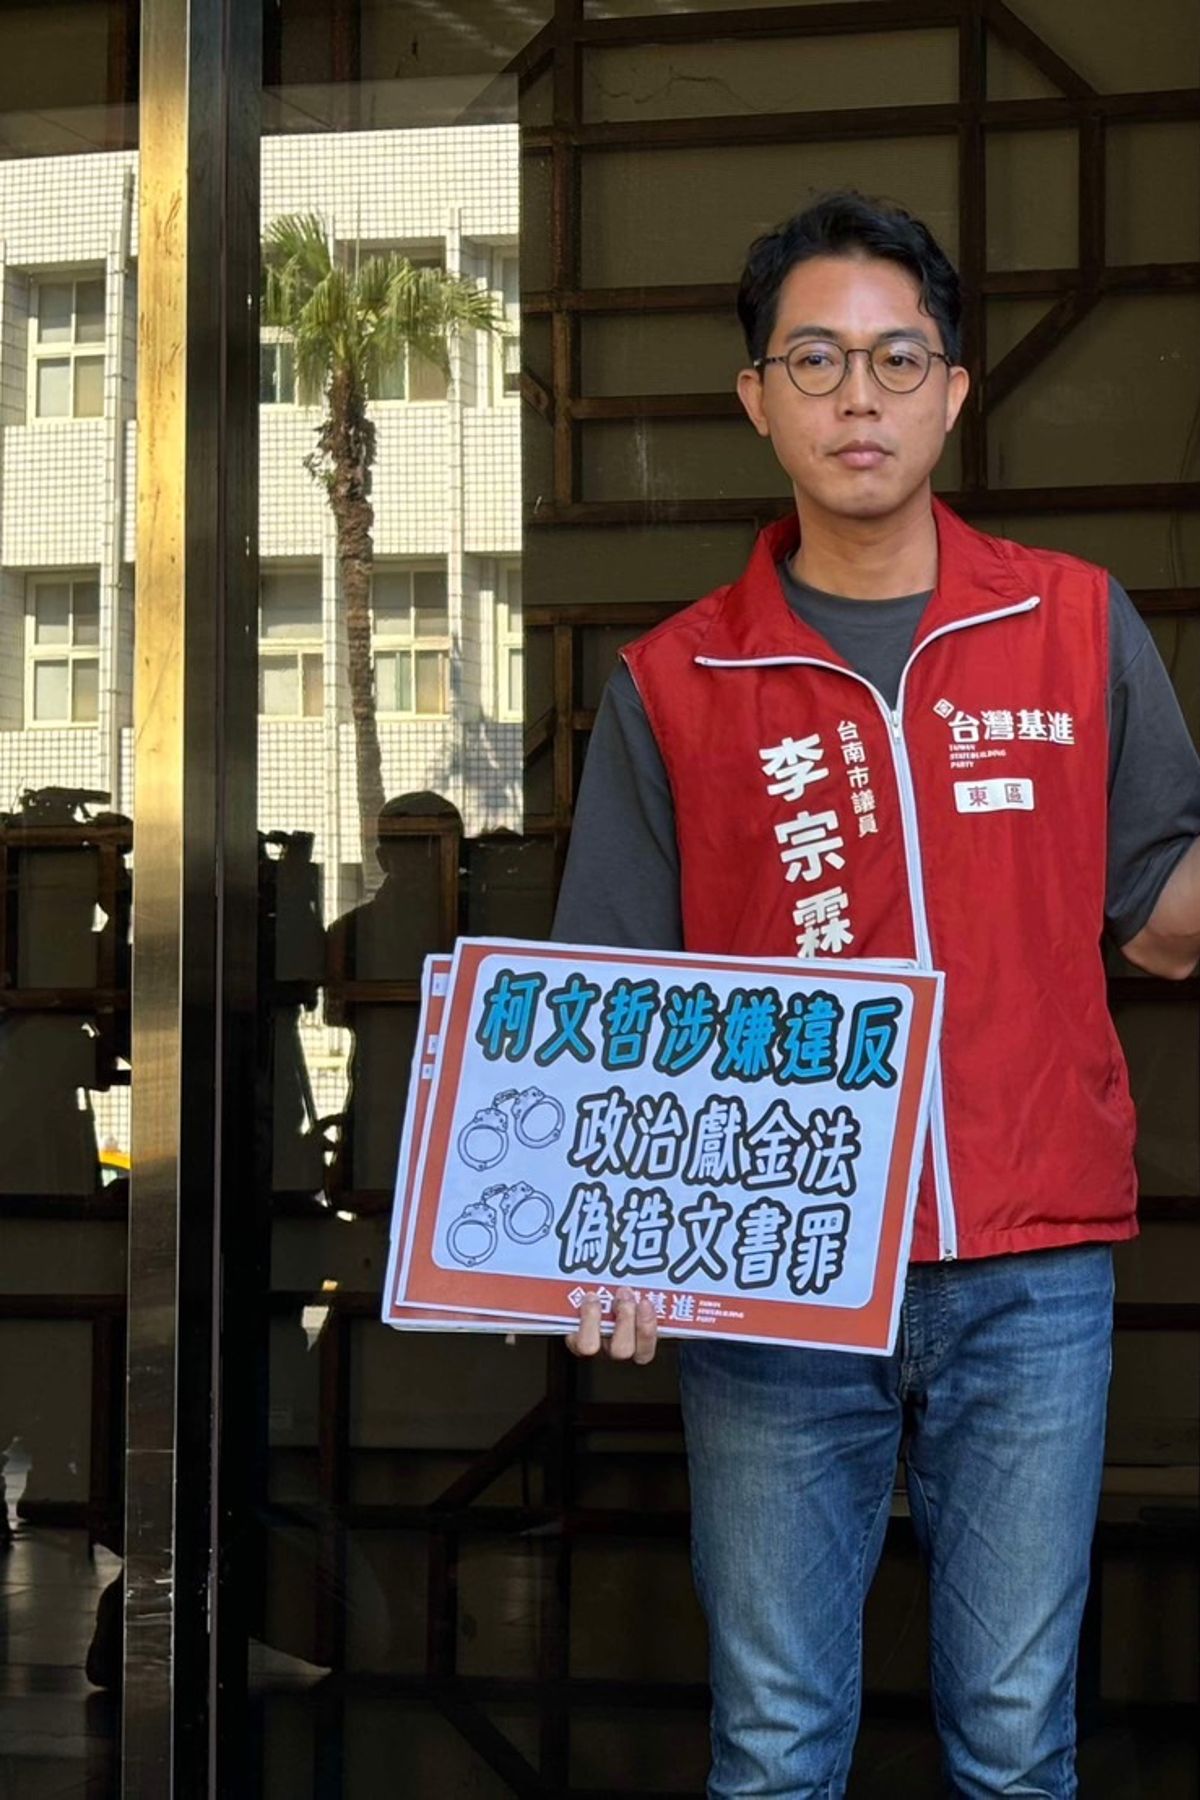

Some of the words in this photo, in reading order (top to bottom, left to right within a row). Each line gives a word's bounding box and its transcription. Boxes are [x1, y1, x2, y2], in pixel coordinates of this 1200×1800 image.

[837, 719, 880, 839] 台南市議員
[948, 709, 1076, 745] 台灣基進
[759, 732, 855, 959] 李宗霖
[967, 783, 1025, 808] 東區
[476, 968, 904, 1091] 柯文哲涉嫌違反
[567, 1085, 861, 1197] 政治獻金法
[556, 1181, 850, 1295] 偽造文書罪
[594, 1286, 696, 1323] 台基進
